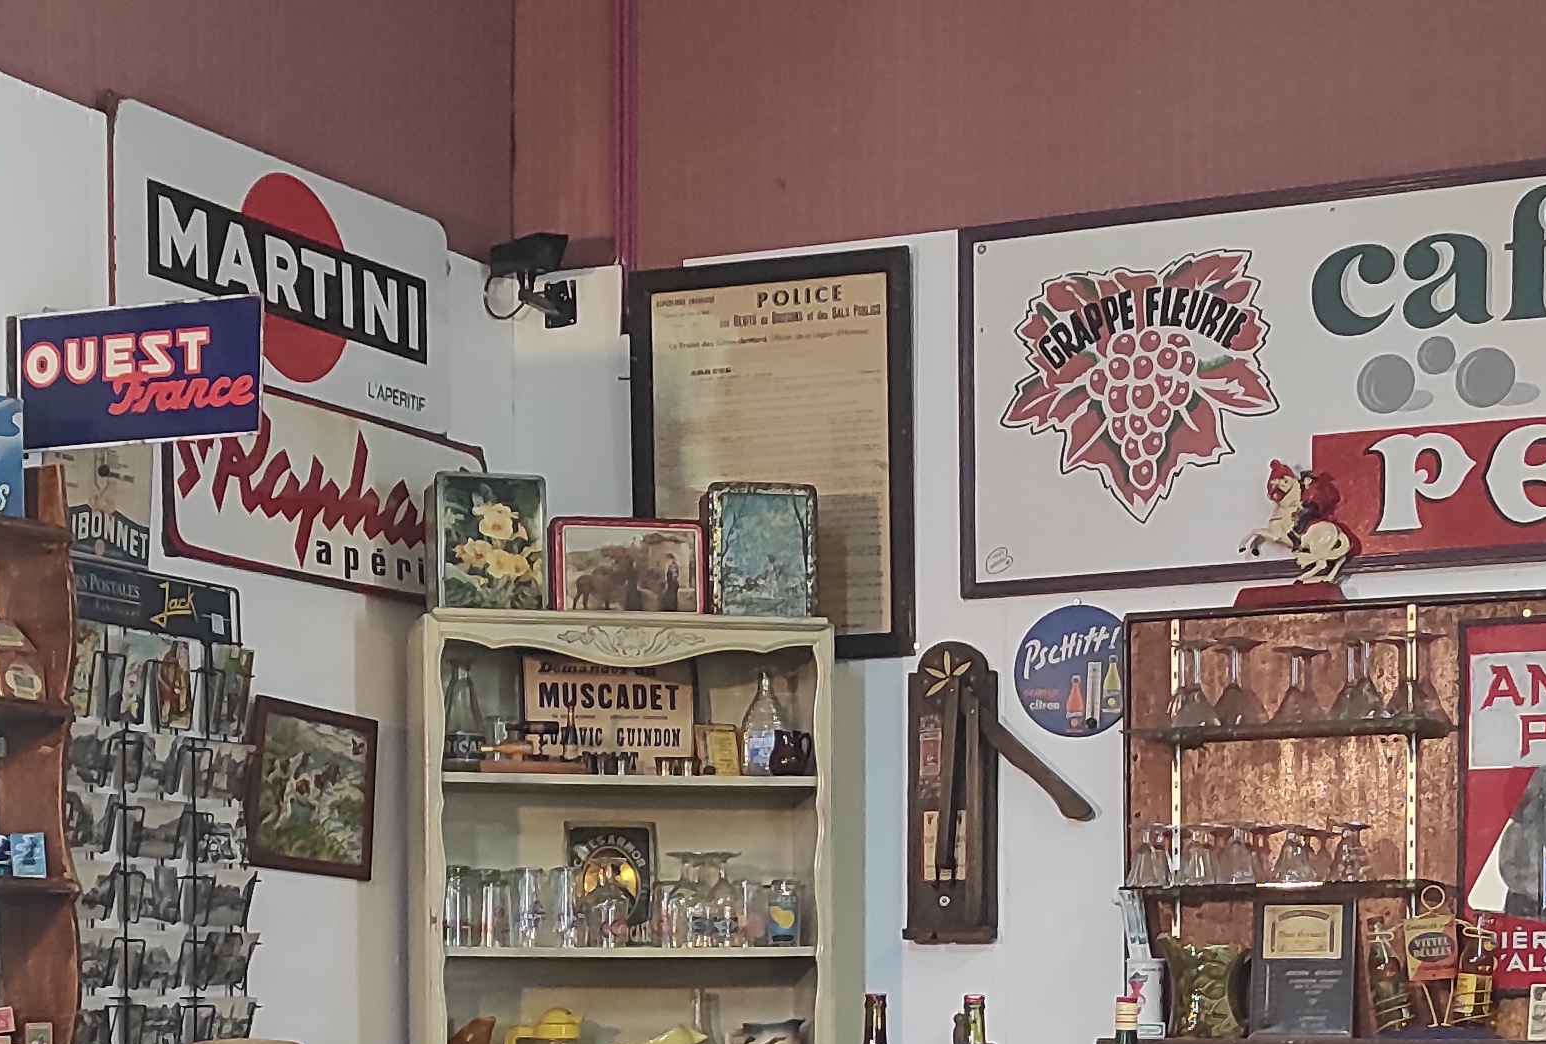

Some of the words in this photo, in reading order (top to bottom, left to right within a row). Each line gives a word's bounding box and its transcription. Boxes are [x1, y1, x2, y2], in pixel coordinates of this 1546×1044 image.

[154, 194, 424, 356] MARTINI
[756, 284, 843, 308] POLICE
[1039, 287, 1137, 371] GRAPPE
[1145, 286, 1246, 349] FLEURIE
[23, 326, 211, 389] OUEST
[109, 371, 255, 416] France
[539, 682, 679, 710] MUSCADET
[616, 727, 681, 747] GUINDON
